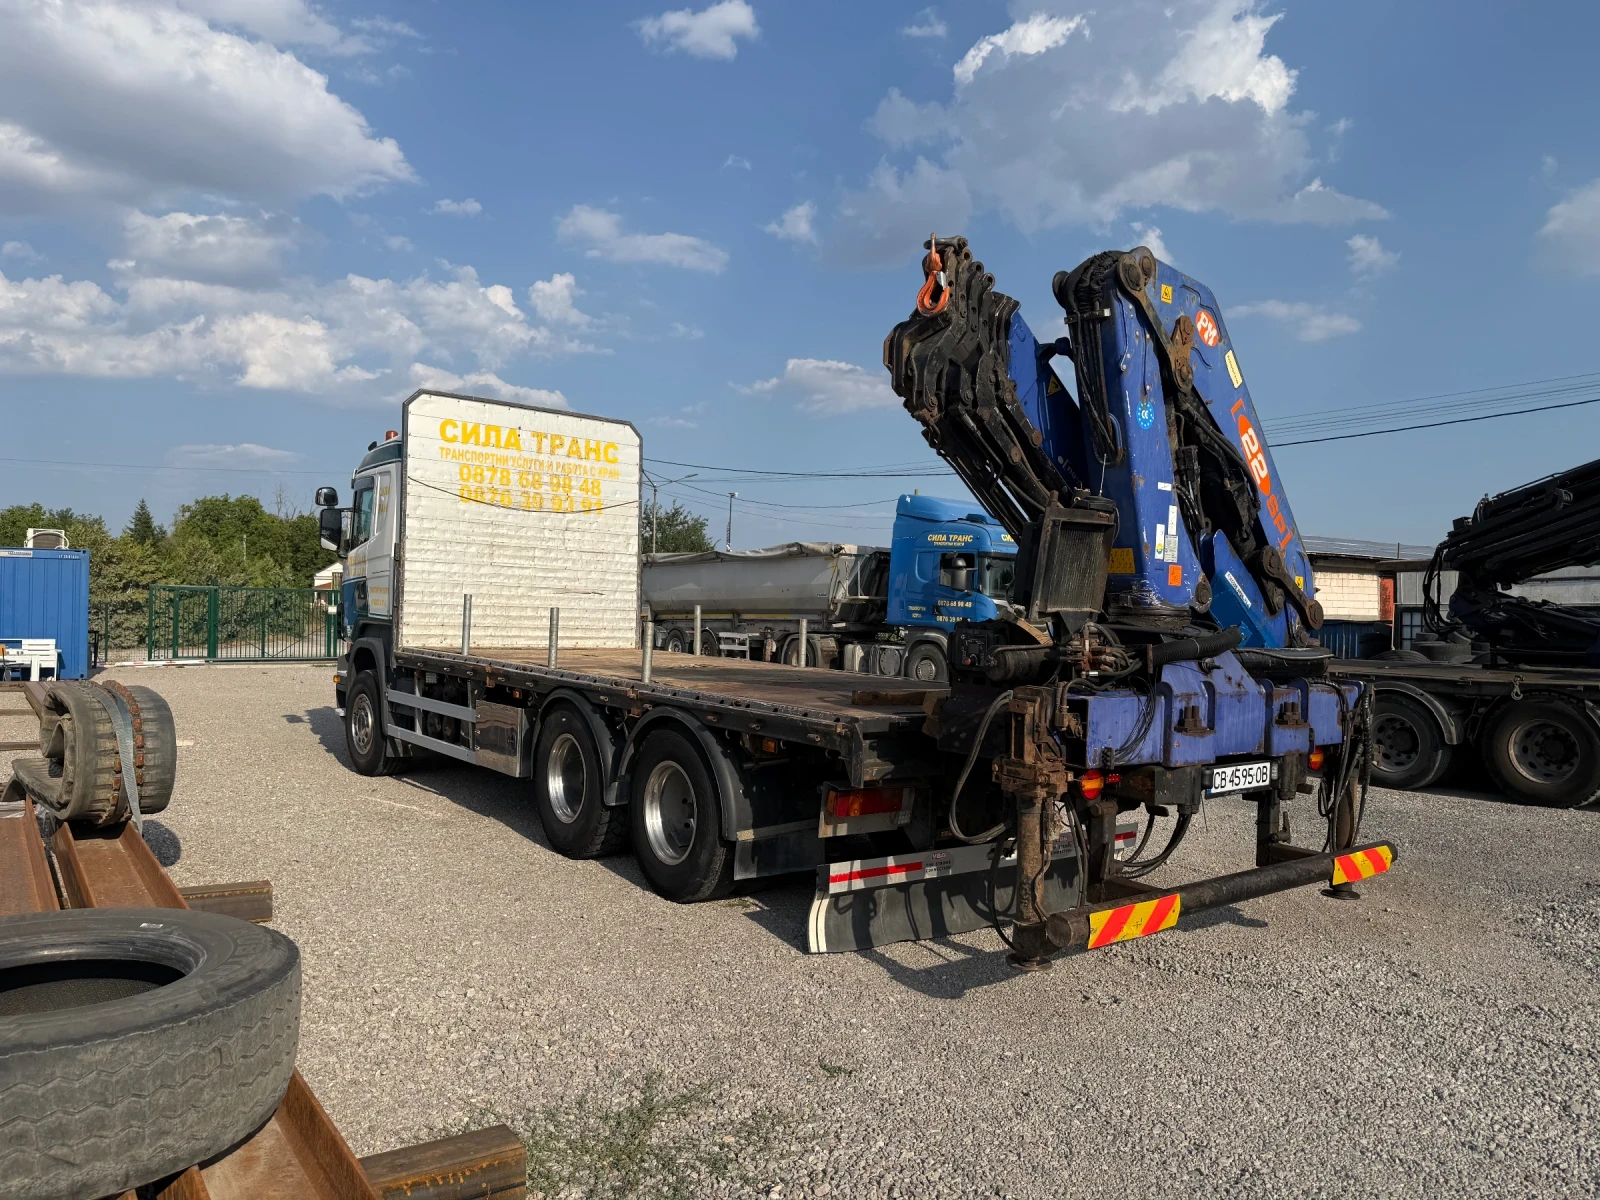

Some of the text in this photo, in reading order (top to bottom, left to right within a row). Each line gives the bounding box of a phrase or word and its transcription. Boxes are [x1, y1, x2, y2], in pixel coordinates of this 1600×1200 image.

[1197, 311, 1218, 346] PM
[439, 419, 619, 465] СИЛА ТРАНС
[1241, 427, 1268, 485] 22
[439, 446, 509, 467] ТРАНСПОРТНИ
[511, 456, 544, 471] УСЛУГИ
[555, 462, 588, 475] РАБОТА
[459, 463, 603, 498] 0878 68 98 48
[459, 484, 514, 507] 0876
[520, 492, 545, 511] 39
[580, 497, 603, 515] 91
[927, 534, 946, 542] СИЛА
[1213, 765, 1268, 789] CB 4595 OB
